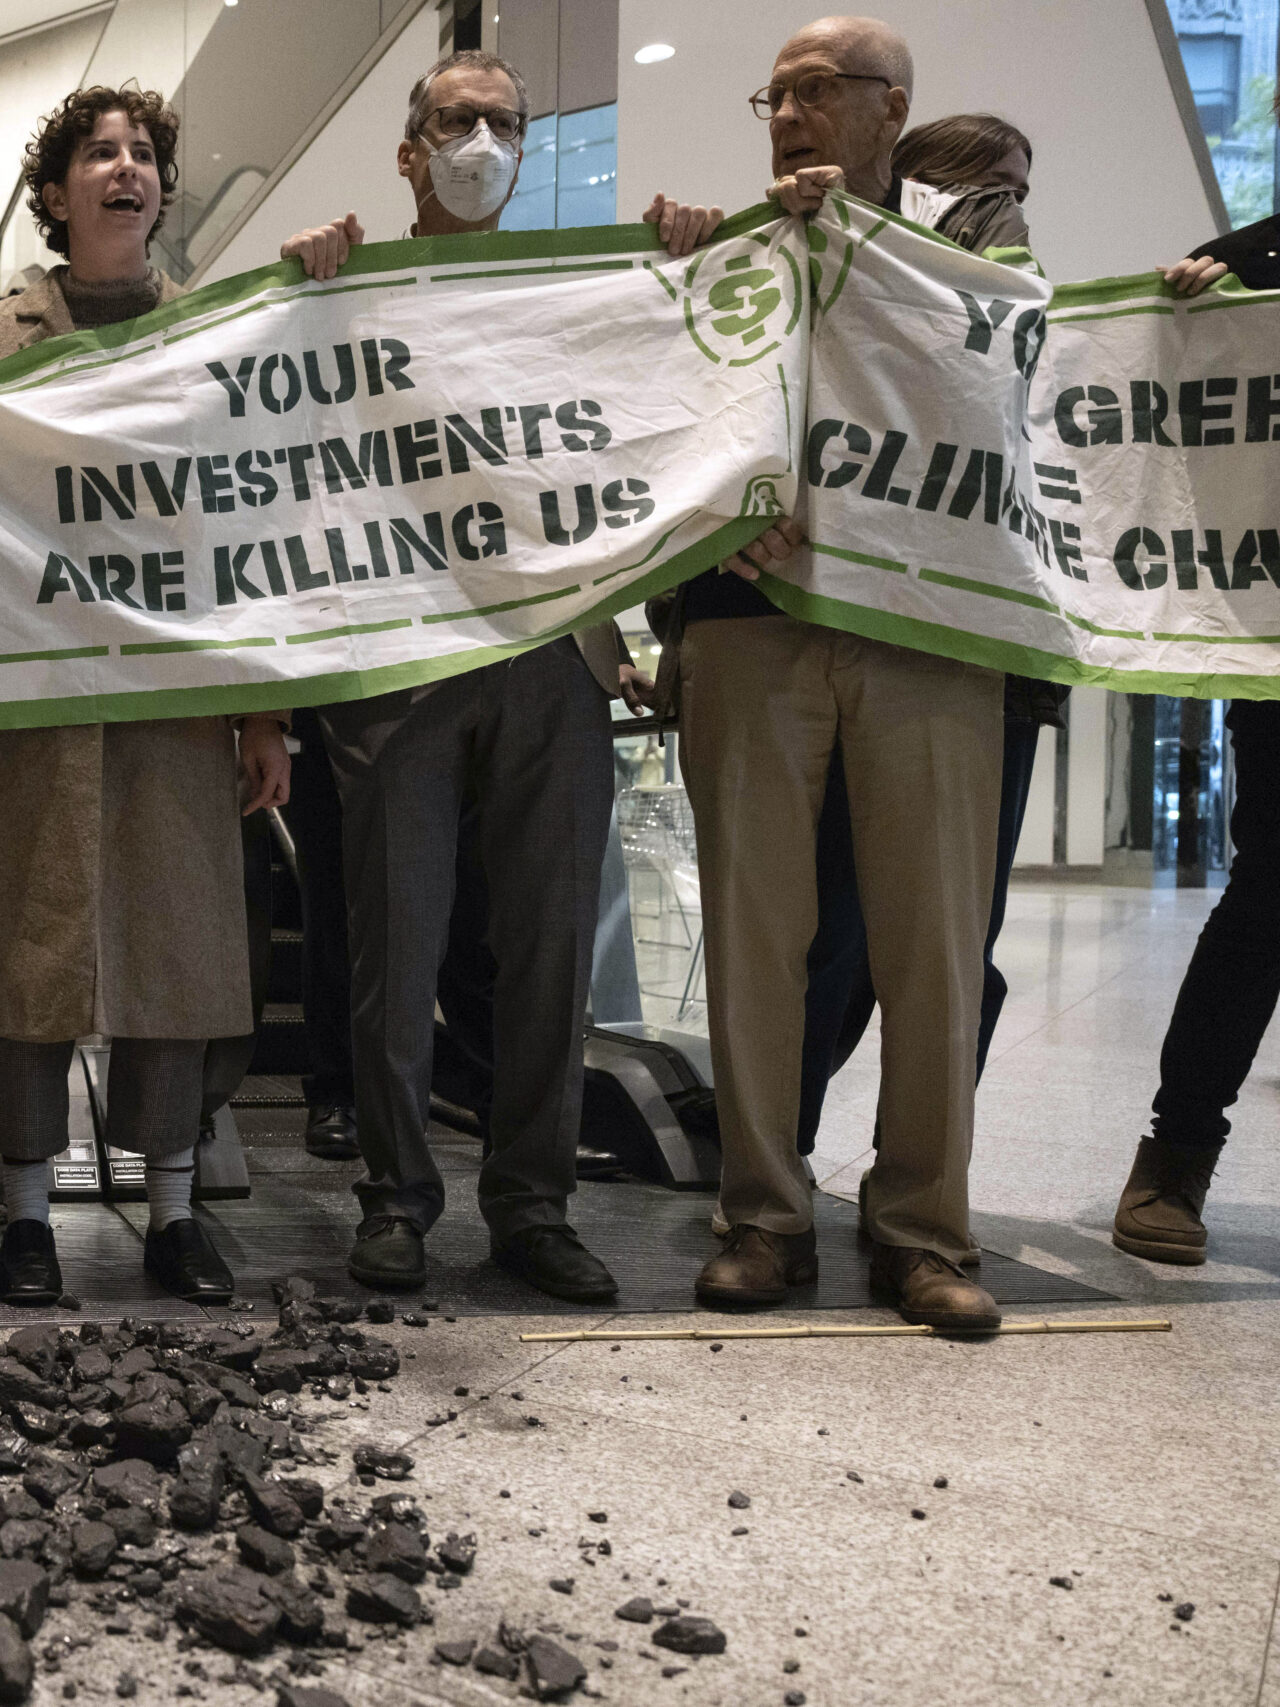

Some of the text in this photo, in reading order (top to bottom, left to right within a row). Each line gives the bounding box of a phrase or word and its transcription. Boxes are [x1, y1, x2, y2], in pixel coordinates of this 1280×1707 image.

[205, 338, 416, 417] YOUR
[55, 399, 612, 523] INVESTMENTS
[37, 477, 656, 612] ARE KILLING US
